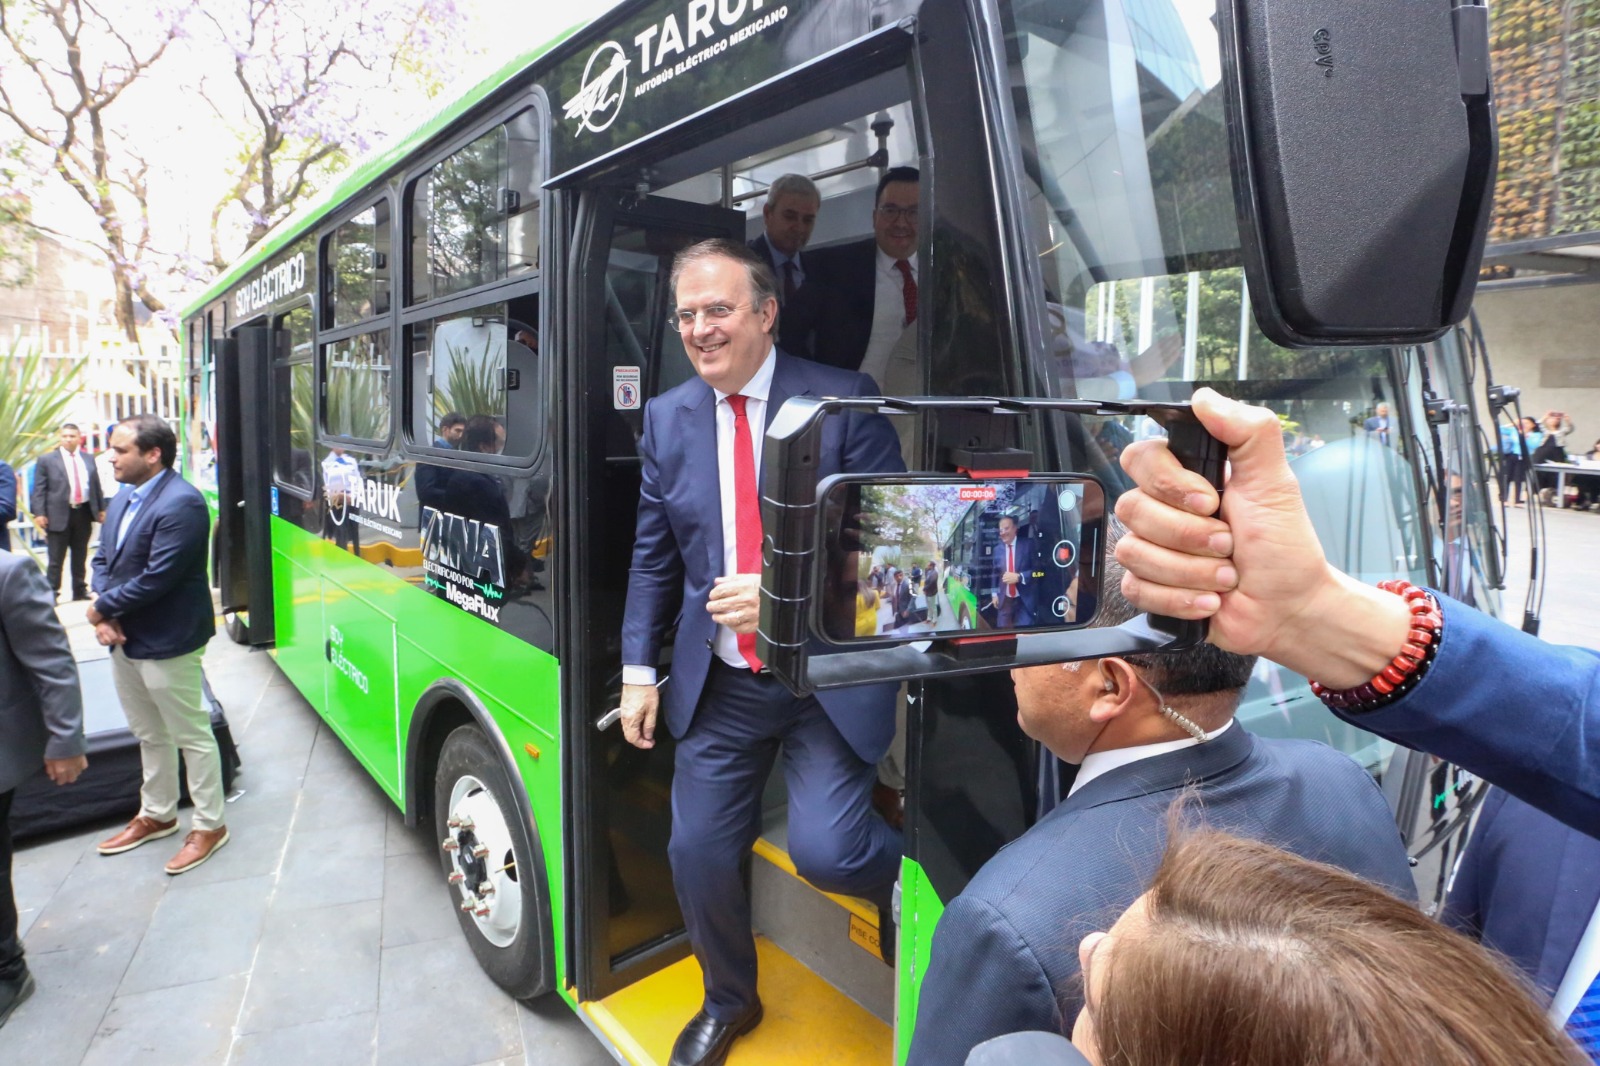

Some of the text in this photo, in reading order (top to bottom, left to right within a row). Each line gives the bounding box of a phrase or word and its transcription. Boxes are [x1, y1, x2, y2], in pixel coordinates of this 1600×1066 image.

[634, 0, 764, 74] TARU
[675, 38, 728, 76] ELÉCTRICO
[729, 5, 788, 47] MEXICANO
[348, 475, 401, 523] TARUK
[962, 490, 993, 499] 00:00:06
[422, 559, 475, 590] ELECTRIFICADO POR
[446, 581, 499, 623] MegaFlux
